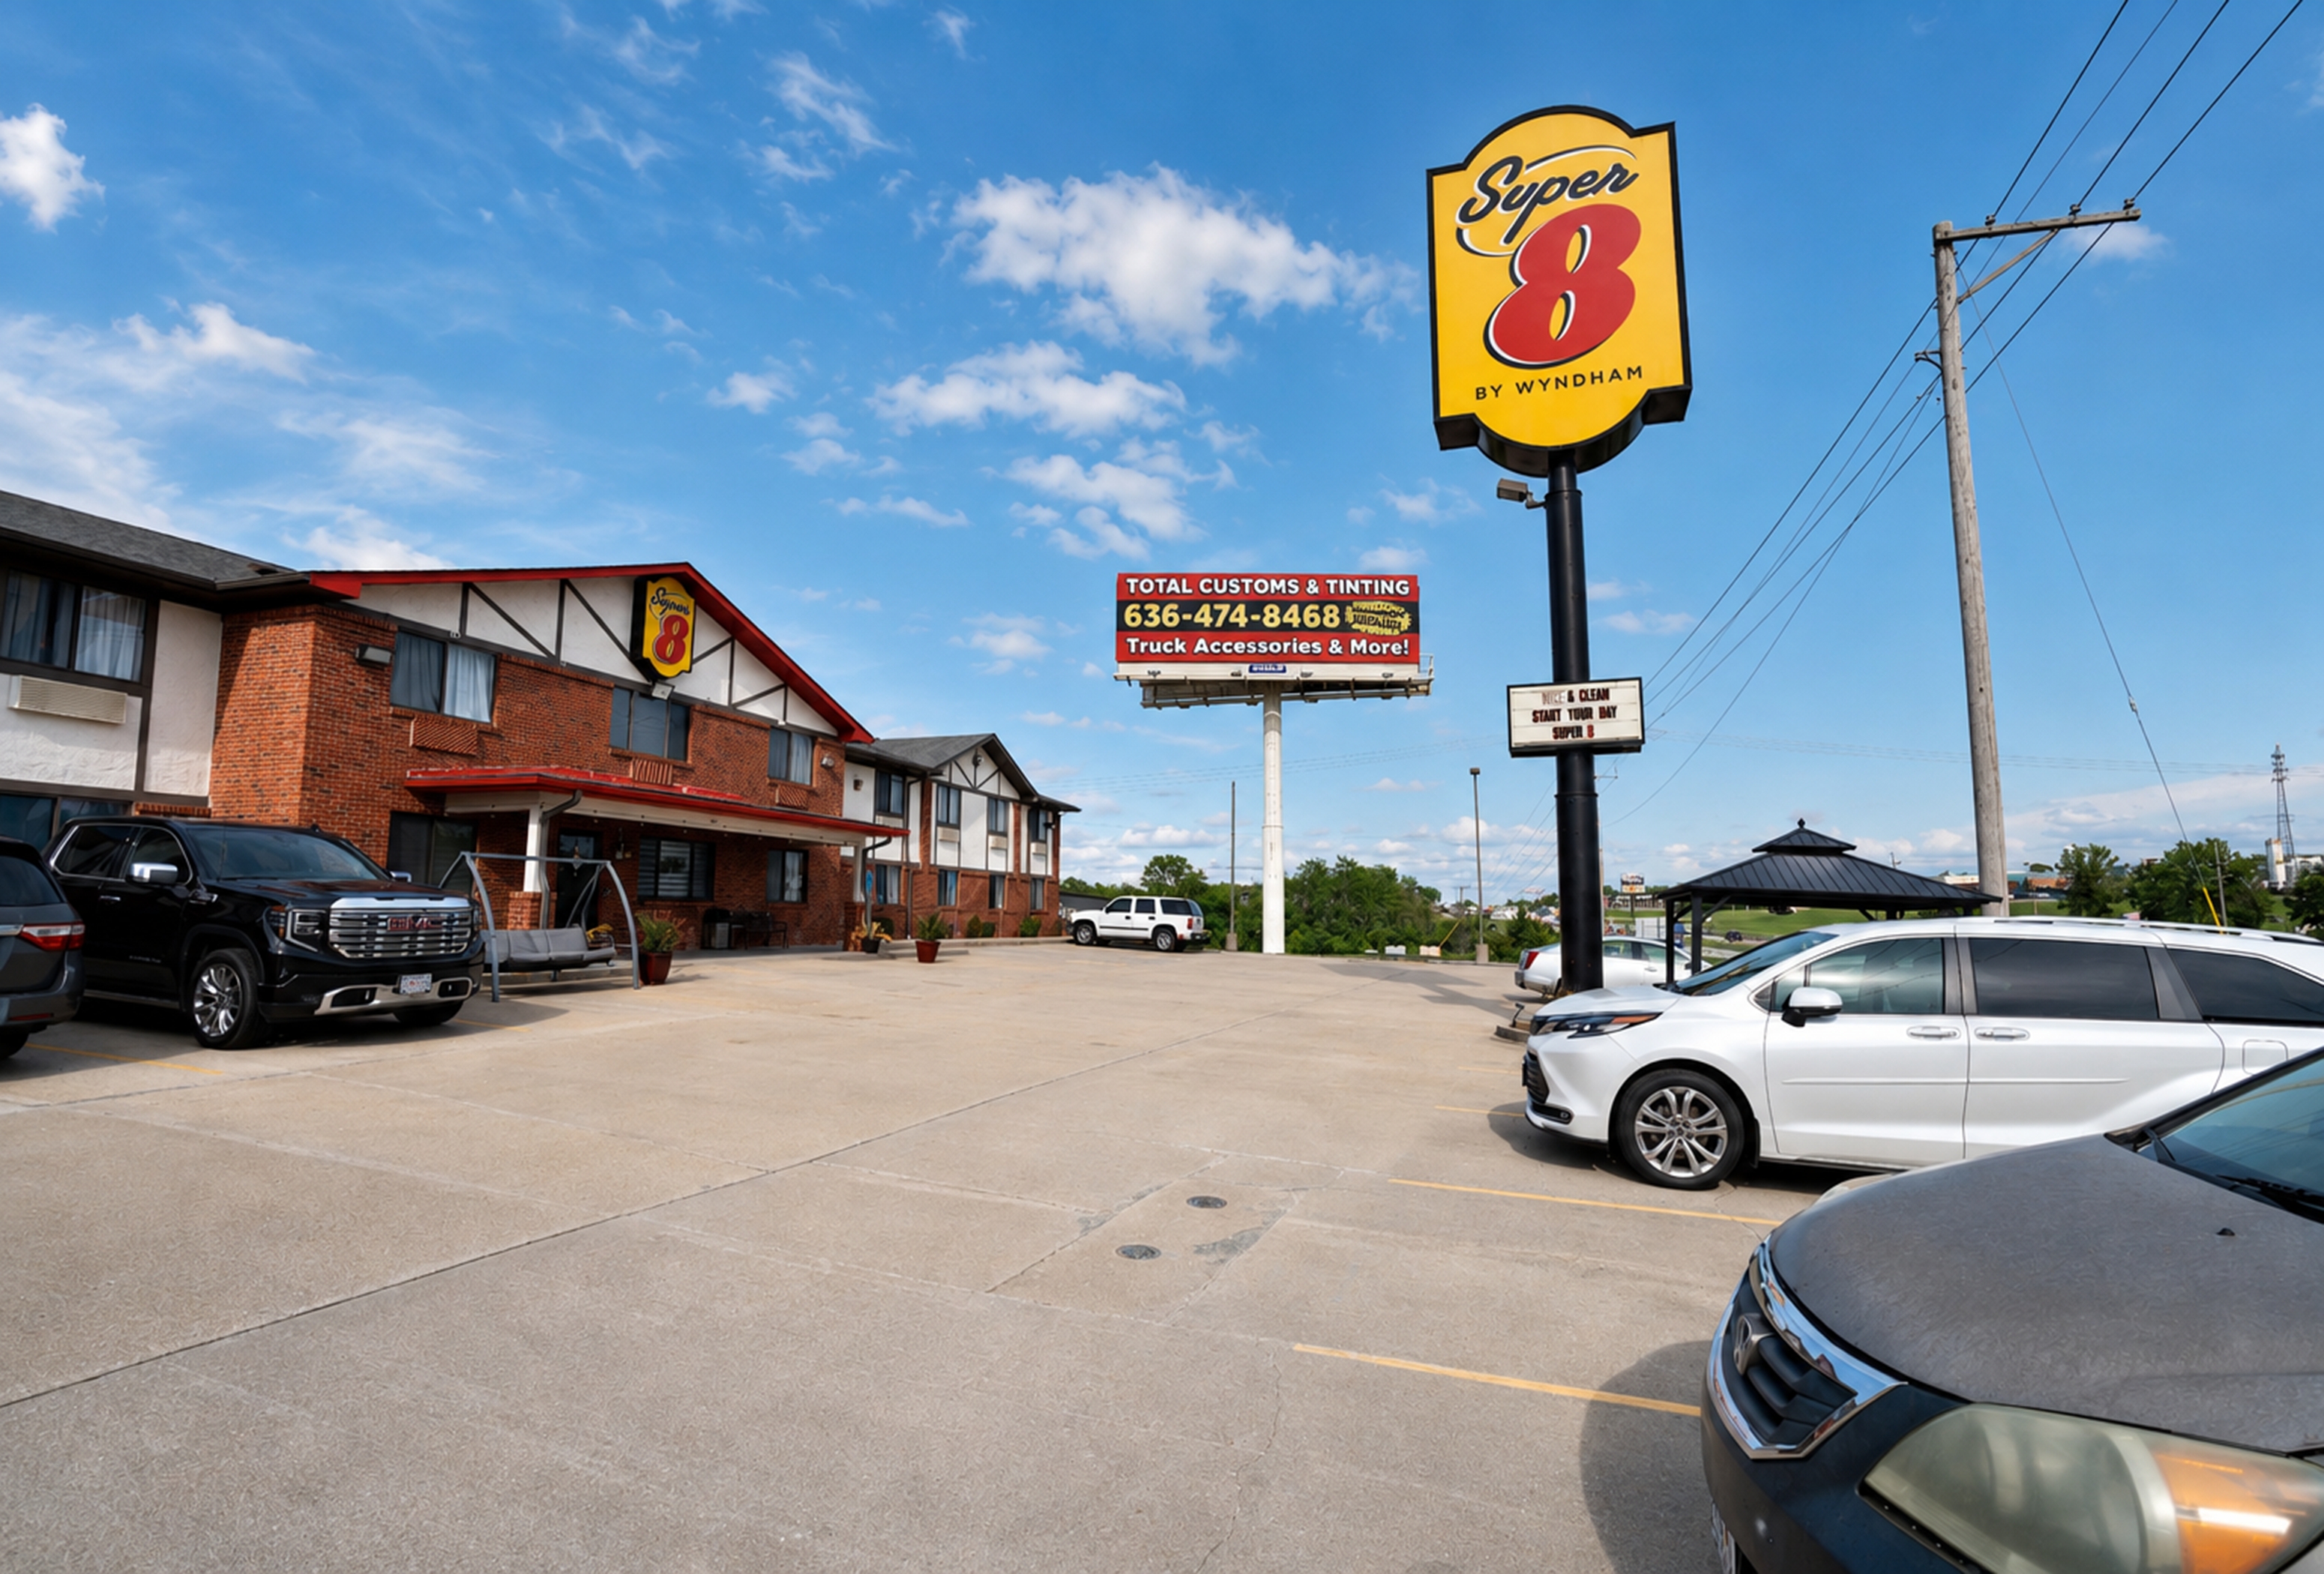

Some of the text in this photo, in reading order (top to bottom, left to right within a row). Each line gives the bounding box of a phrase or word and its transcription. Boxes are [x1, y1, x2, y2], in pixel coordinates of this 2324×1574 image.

[1455, 155, 1639, 246] Super
[1482, 203, 1642, 370] 8
[1475, 366, 1643, 400] BY WYNDHAM
[1126, 578, 1409, 596] TOTAL CUSTOMS & TINTING
[1124, 603, 1340, 628] 636-474-8468
[653, 615, 689, 665] 8
[1126, 638, 1409, 656] Truck Accessories & More!
[1579, 688, 1610, 702] CLEAN
[1532, 705, 1617, 723] START YOUR DAY
[1553, 725, 1583, 740] SUPER
